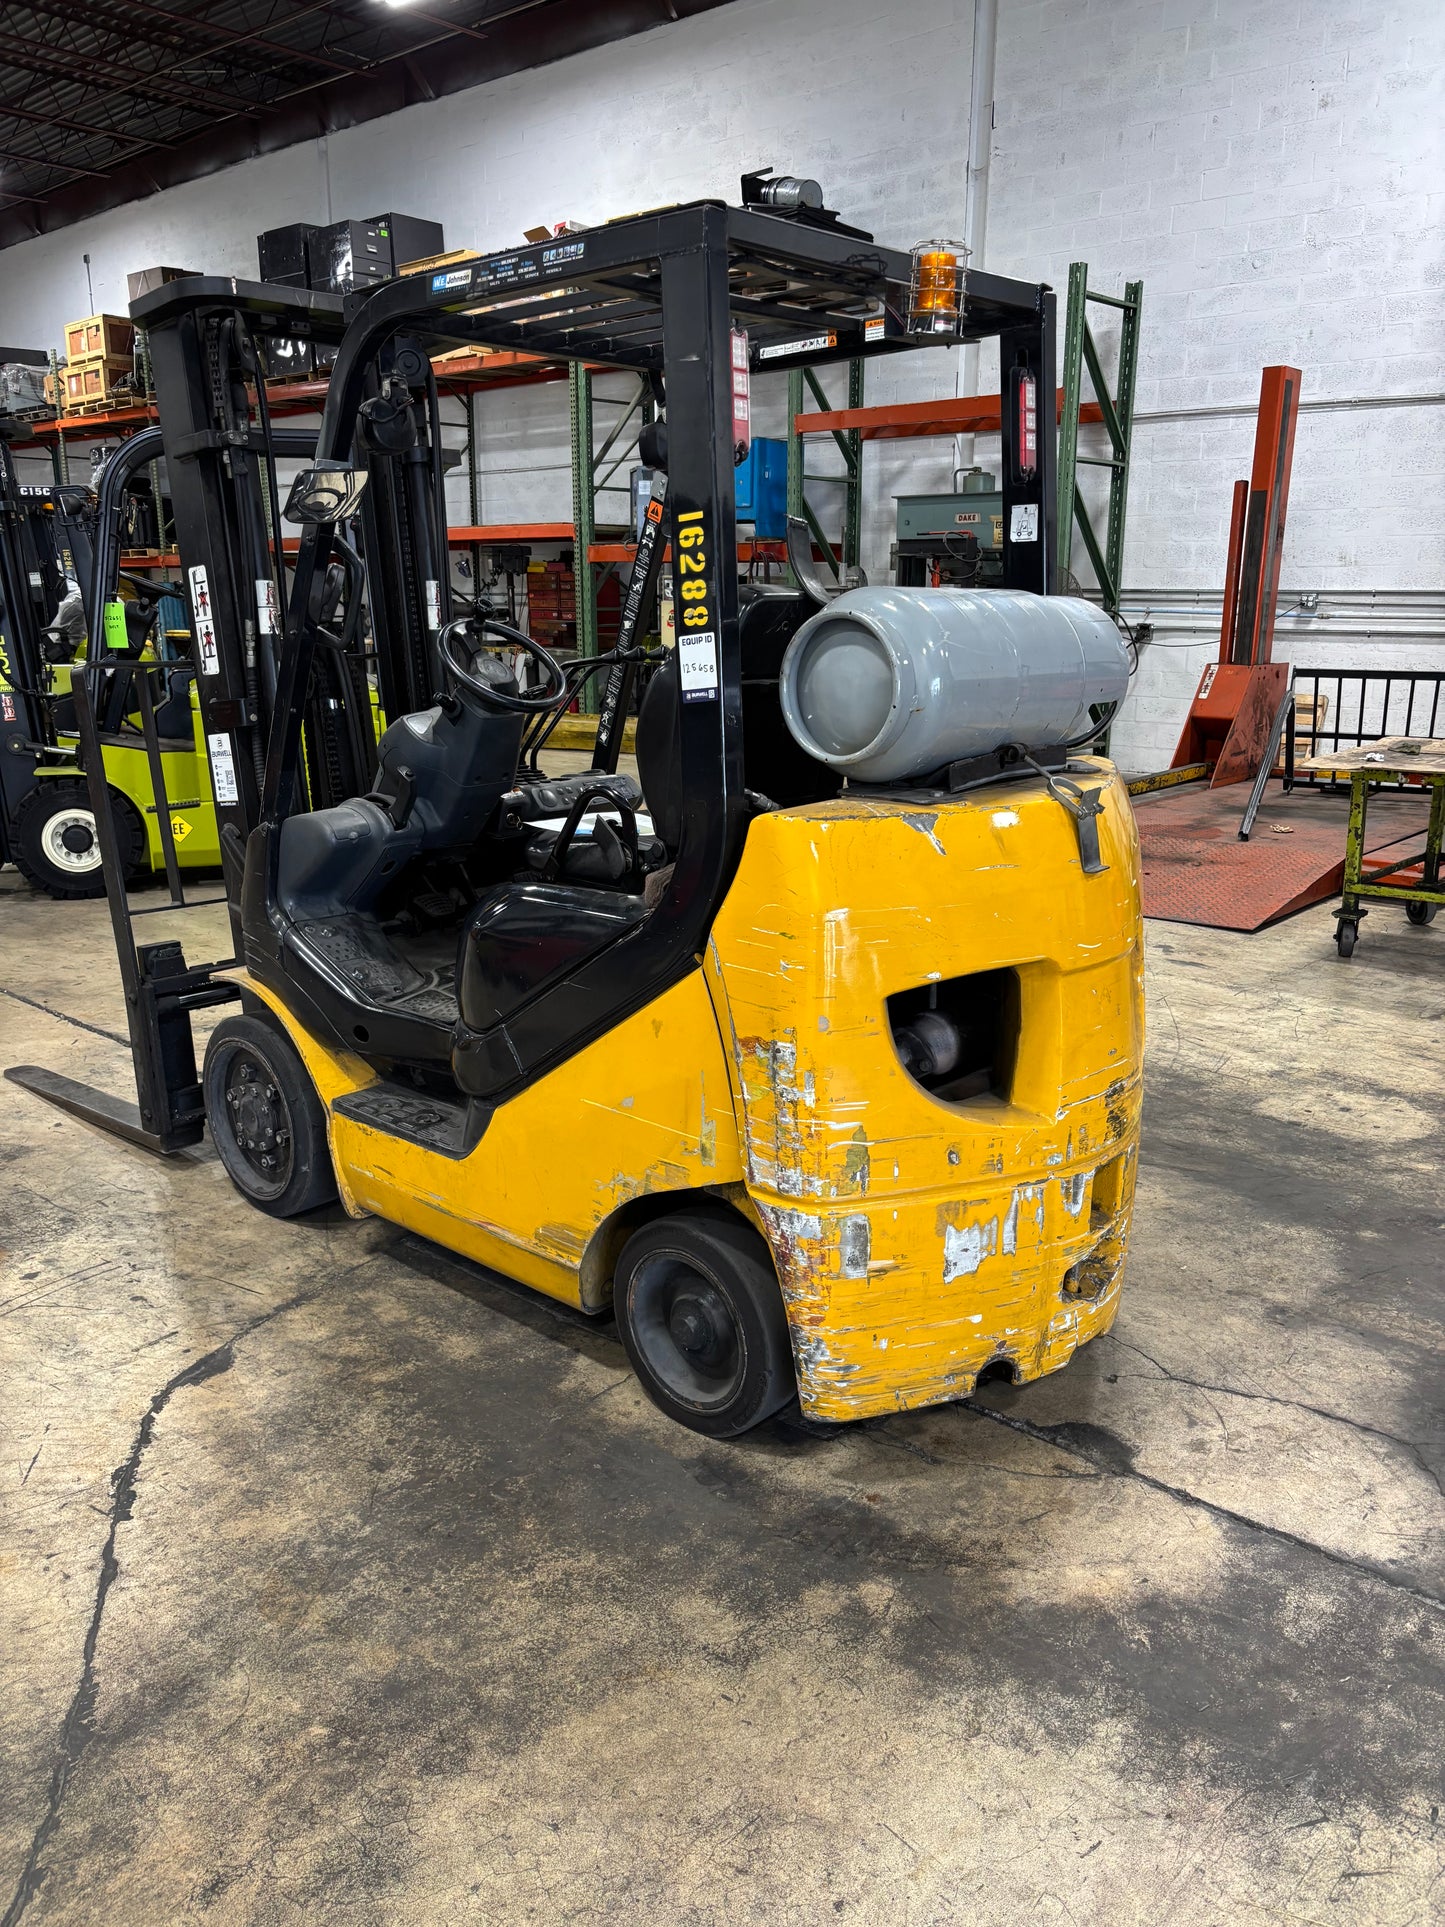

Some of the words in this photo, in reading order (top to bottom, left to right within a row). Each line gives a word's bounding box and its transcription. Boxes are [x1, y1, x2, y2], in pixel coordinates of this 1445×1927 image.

[447, 274, 470, 285] Johnson
[20, 487, 51, 496] C15C
[958, 514, 976, 522] DAKE
[678, 510, 709, 627] 16288
[682, 636, 704, 646] EQUIP
[704, 635, 712, 643] ID
[683, 662, 715, 674] 125658
[211, 750, 232, 758] BURWELL
[173, 823, 185, 834] EE
